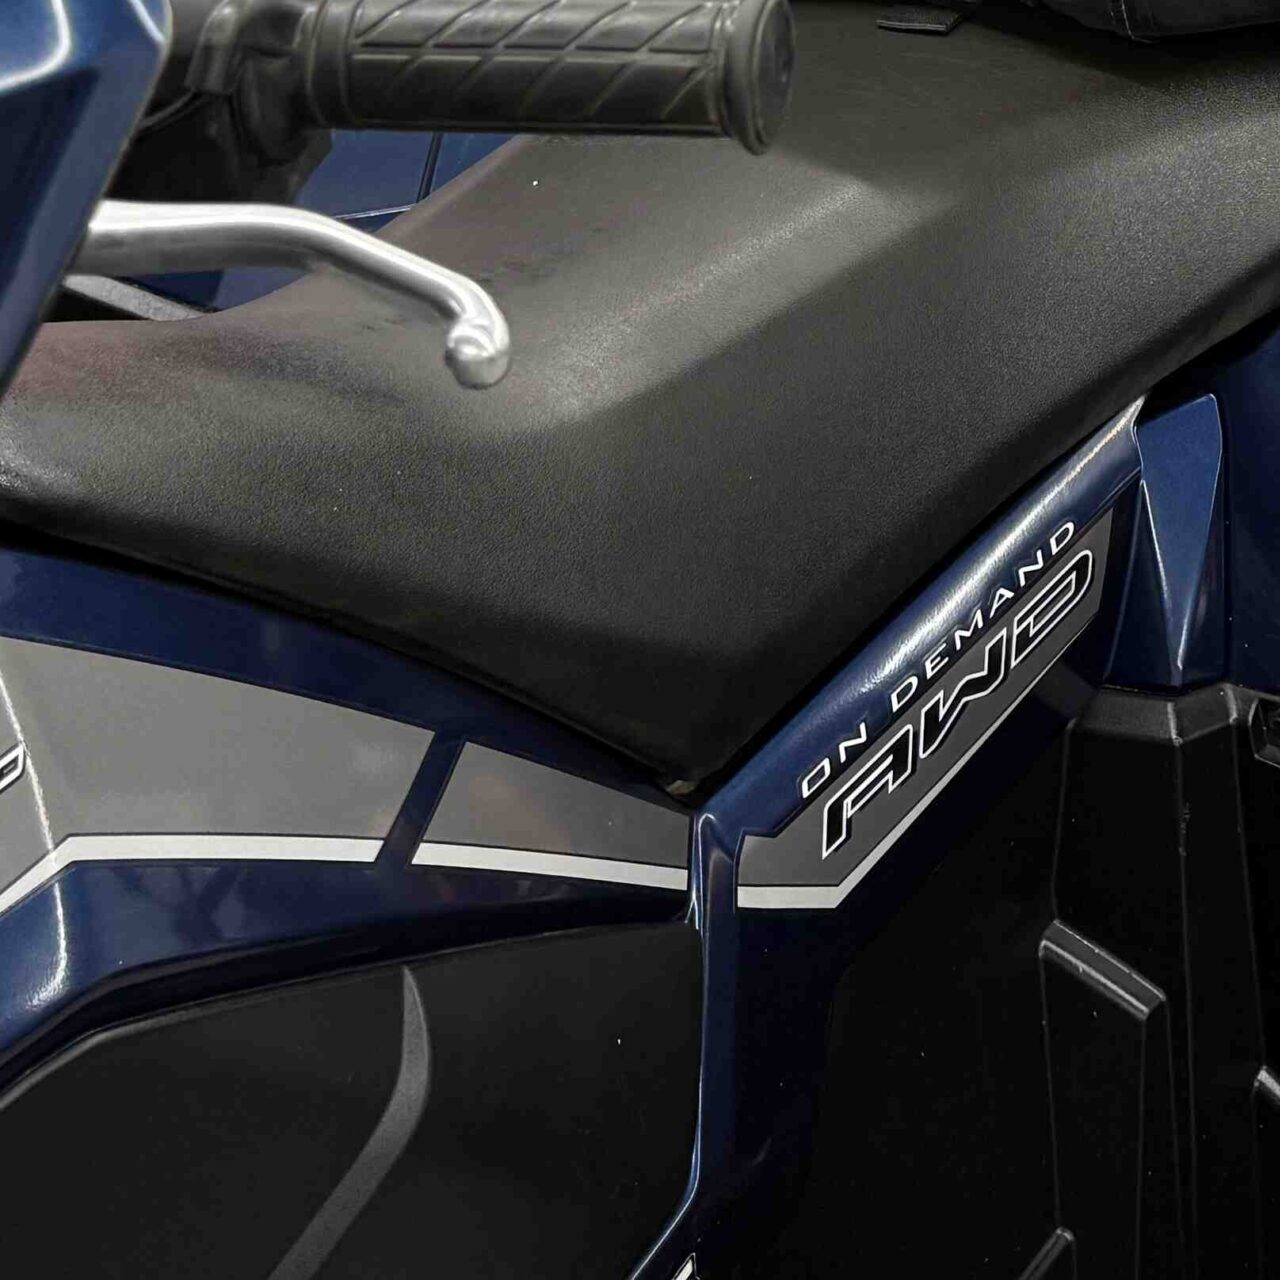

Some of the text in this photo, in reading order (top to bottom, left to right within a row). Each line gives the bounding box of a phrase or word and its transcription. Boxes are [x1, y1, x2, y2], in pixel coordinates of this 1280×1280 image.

[802, 522, 1073, 797] ON DEMAND
[822, 549, 1092, 859] AWD
